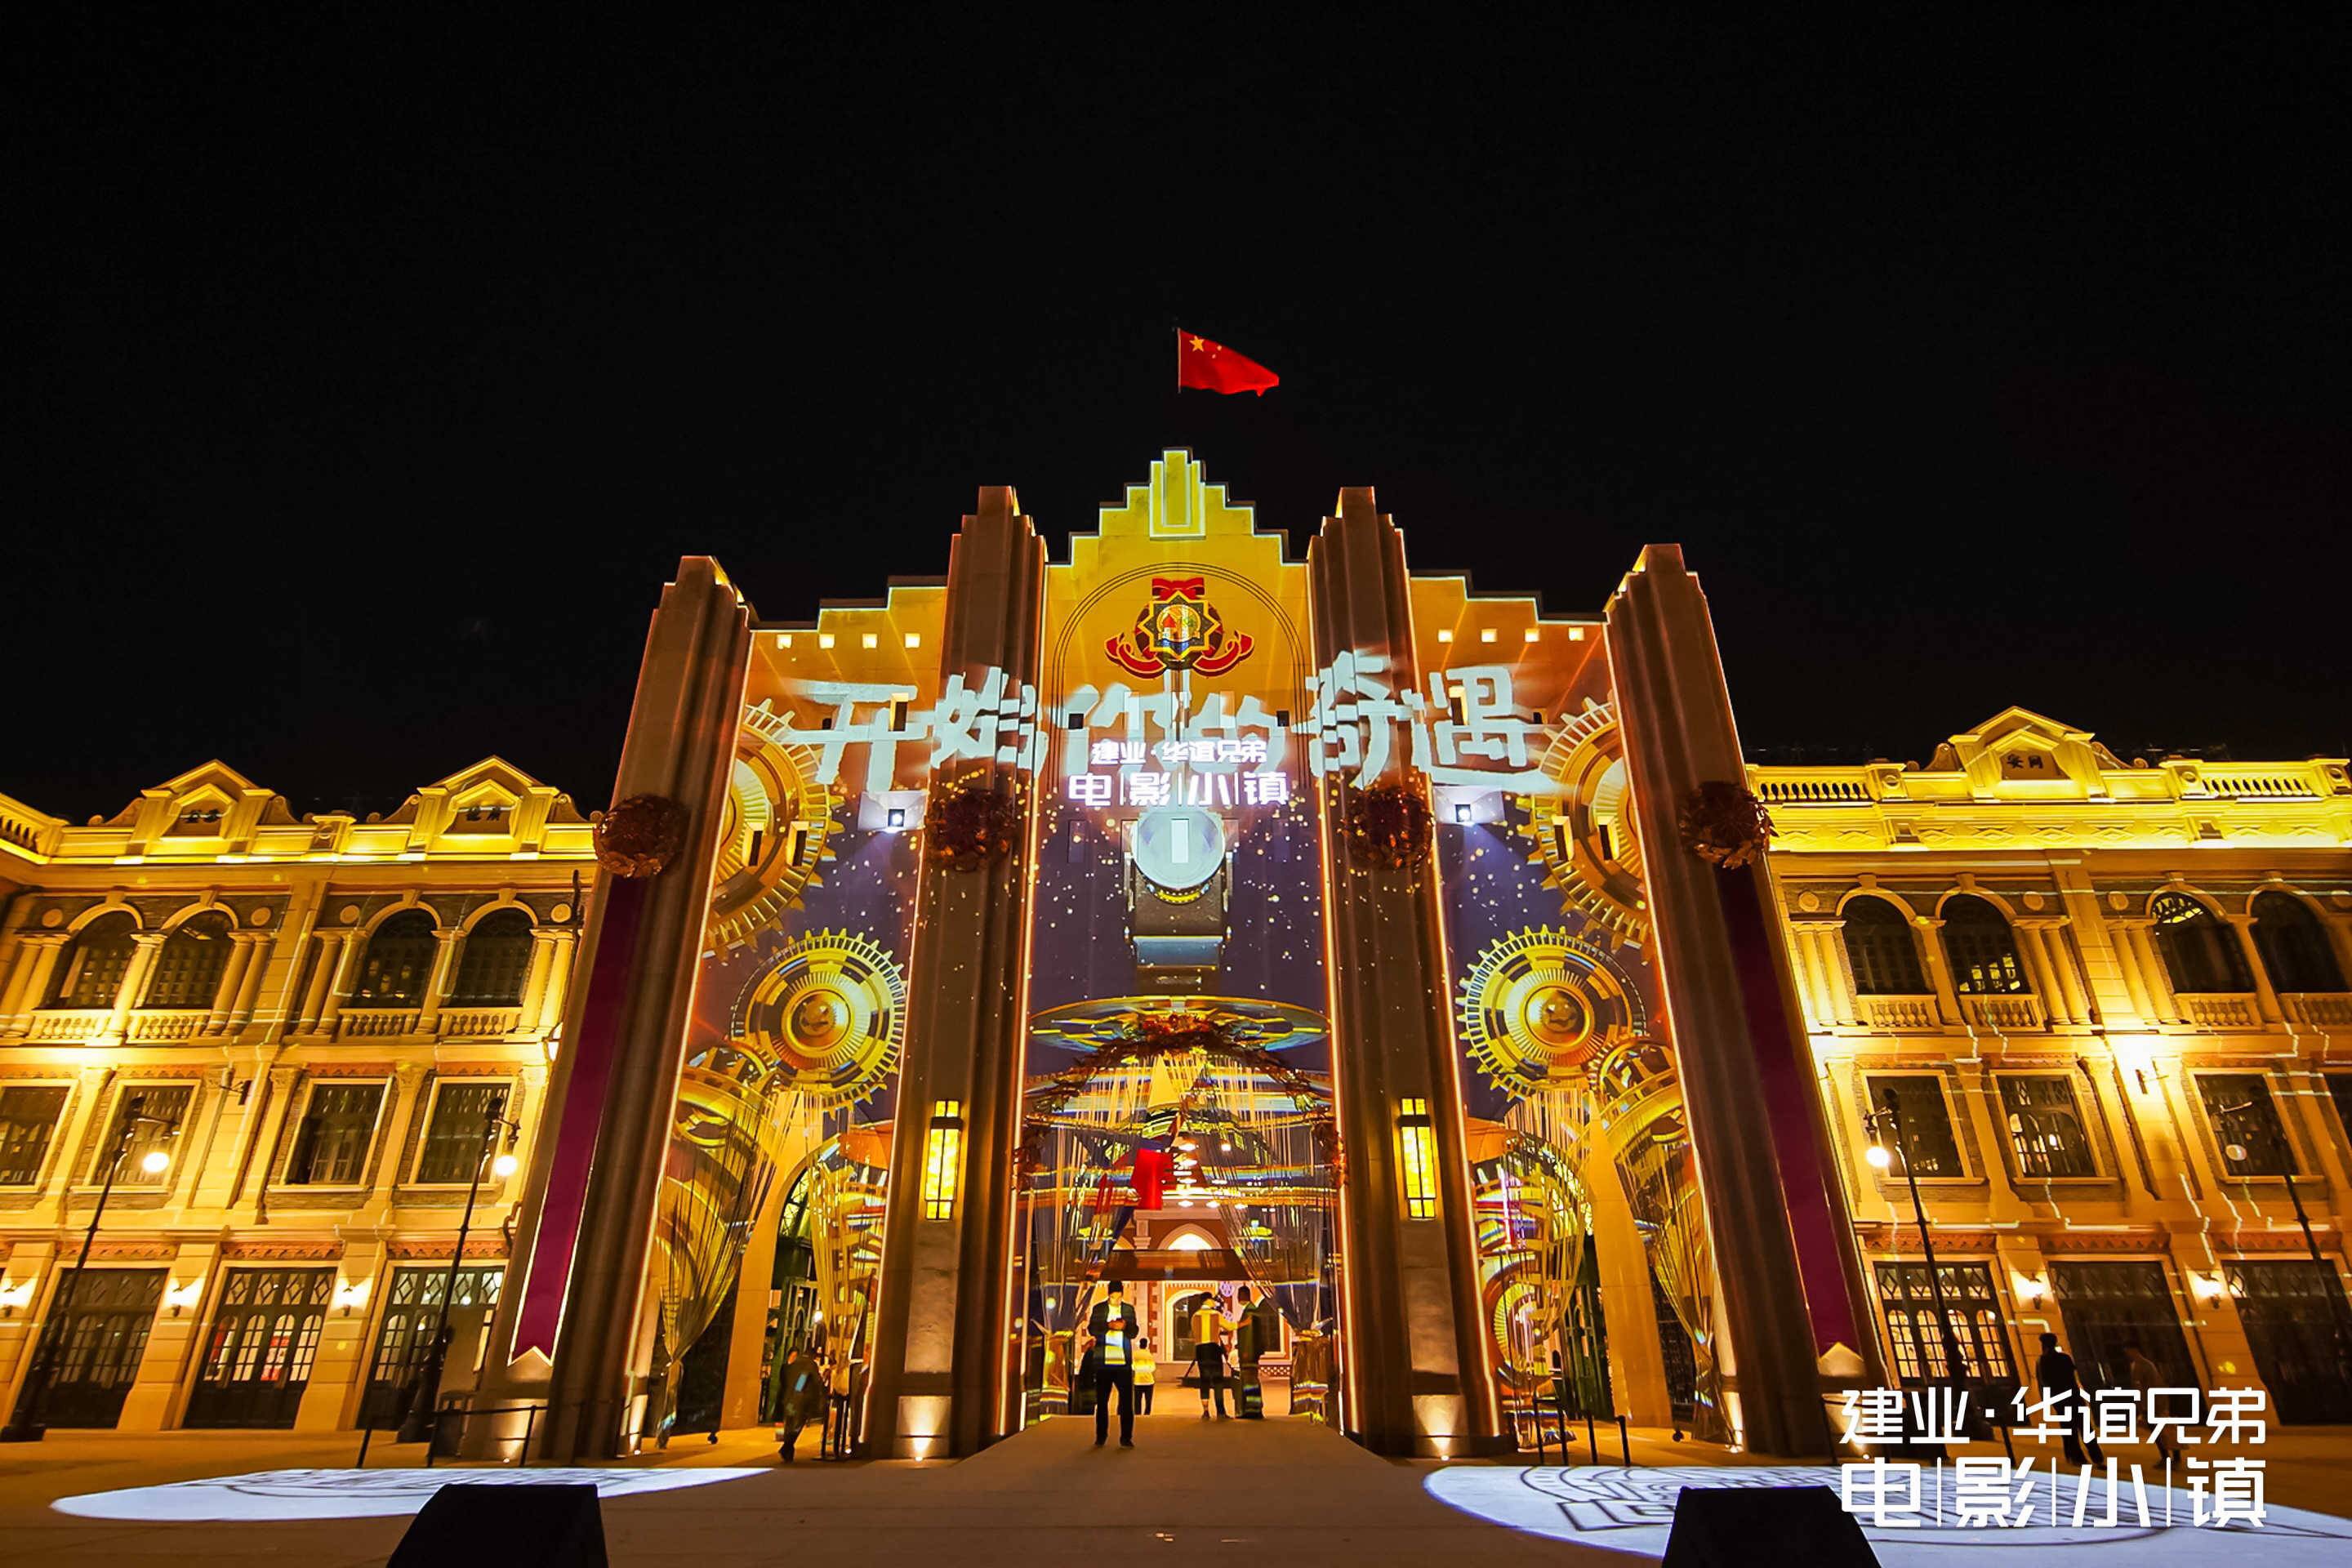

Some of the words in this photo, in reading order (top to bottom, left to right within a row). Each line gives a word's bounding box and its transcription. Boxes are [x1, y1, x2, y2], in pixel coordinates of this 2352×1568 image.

[776, 651, 1564, 794] 开始你的奇遇
